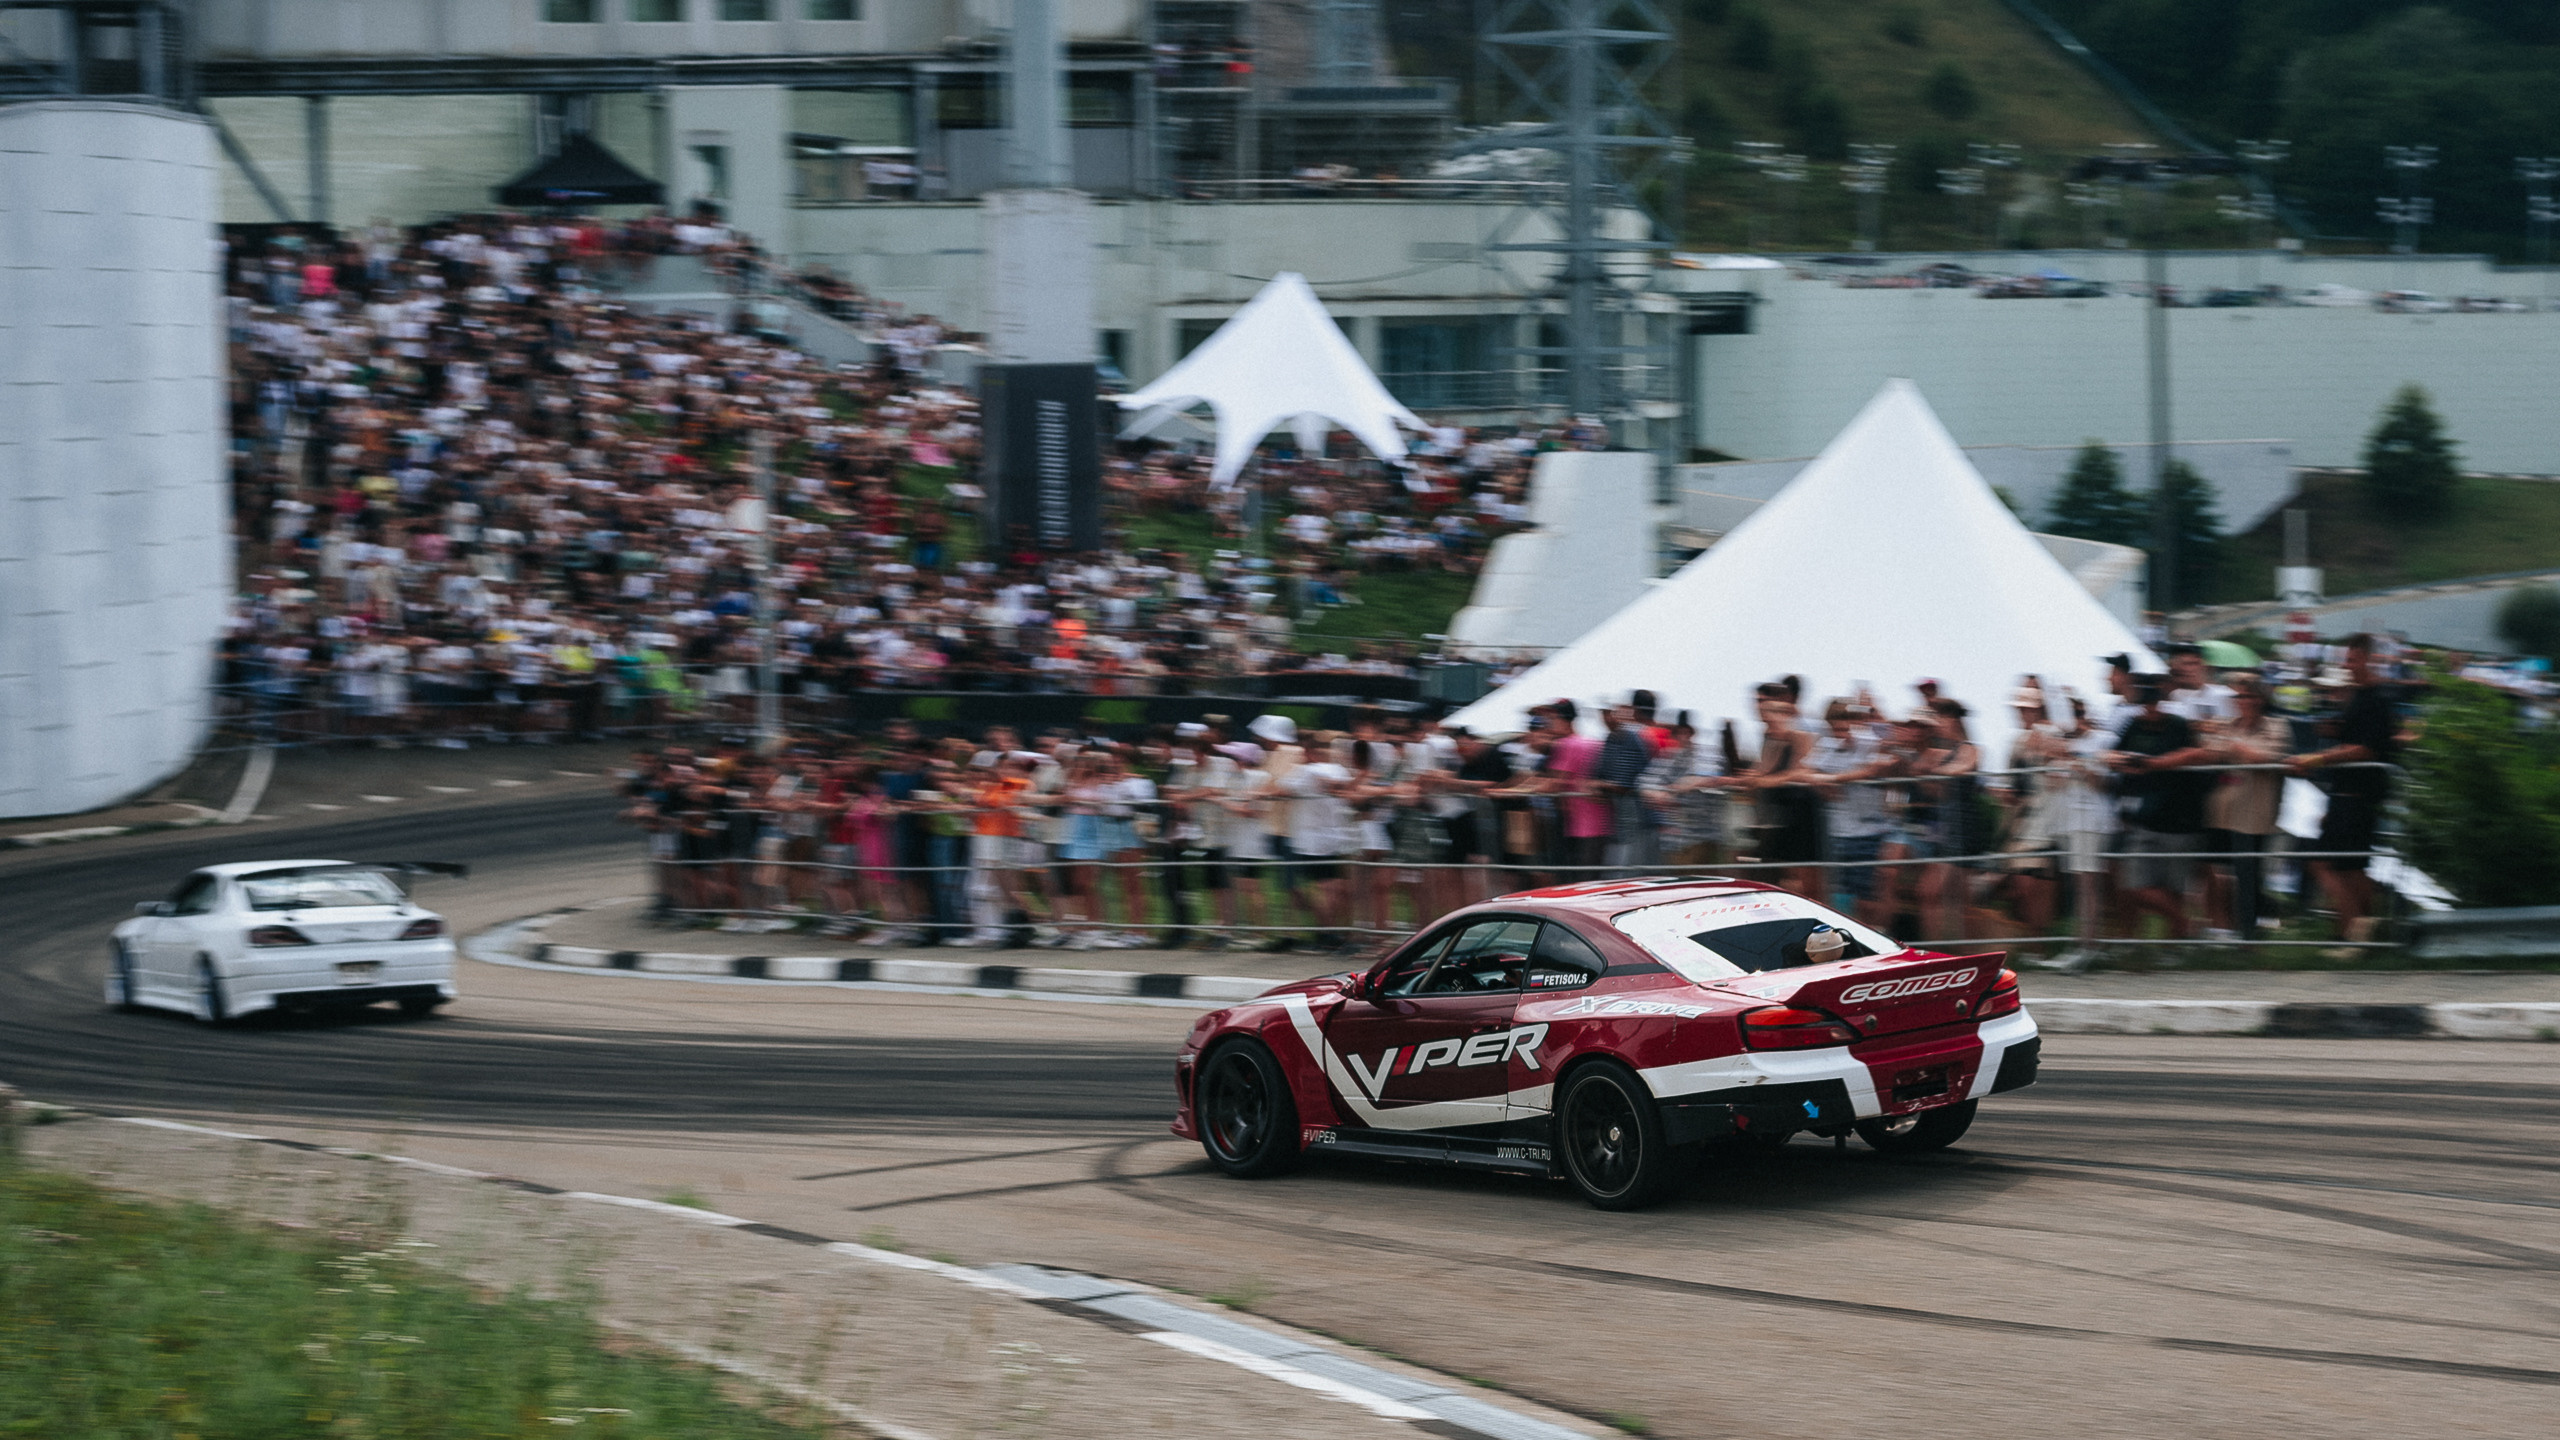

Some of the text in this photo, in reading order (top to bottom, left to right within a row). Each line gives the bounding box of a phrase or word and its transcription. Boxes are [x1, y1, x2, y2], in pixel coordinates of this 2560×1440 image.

[1544, 973, 1588, 986] FETISOV.S
[1840, 967, 1978, 1004] COMBO
[1347, 1023, 1549, 1102] VIPER
[1303, 1129, 1337, 1144] #VIPER
[1497, 1146, 1551, 1160] WWW.C-TRI.RU
